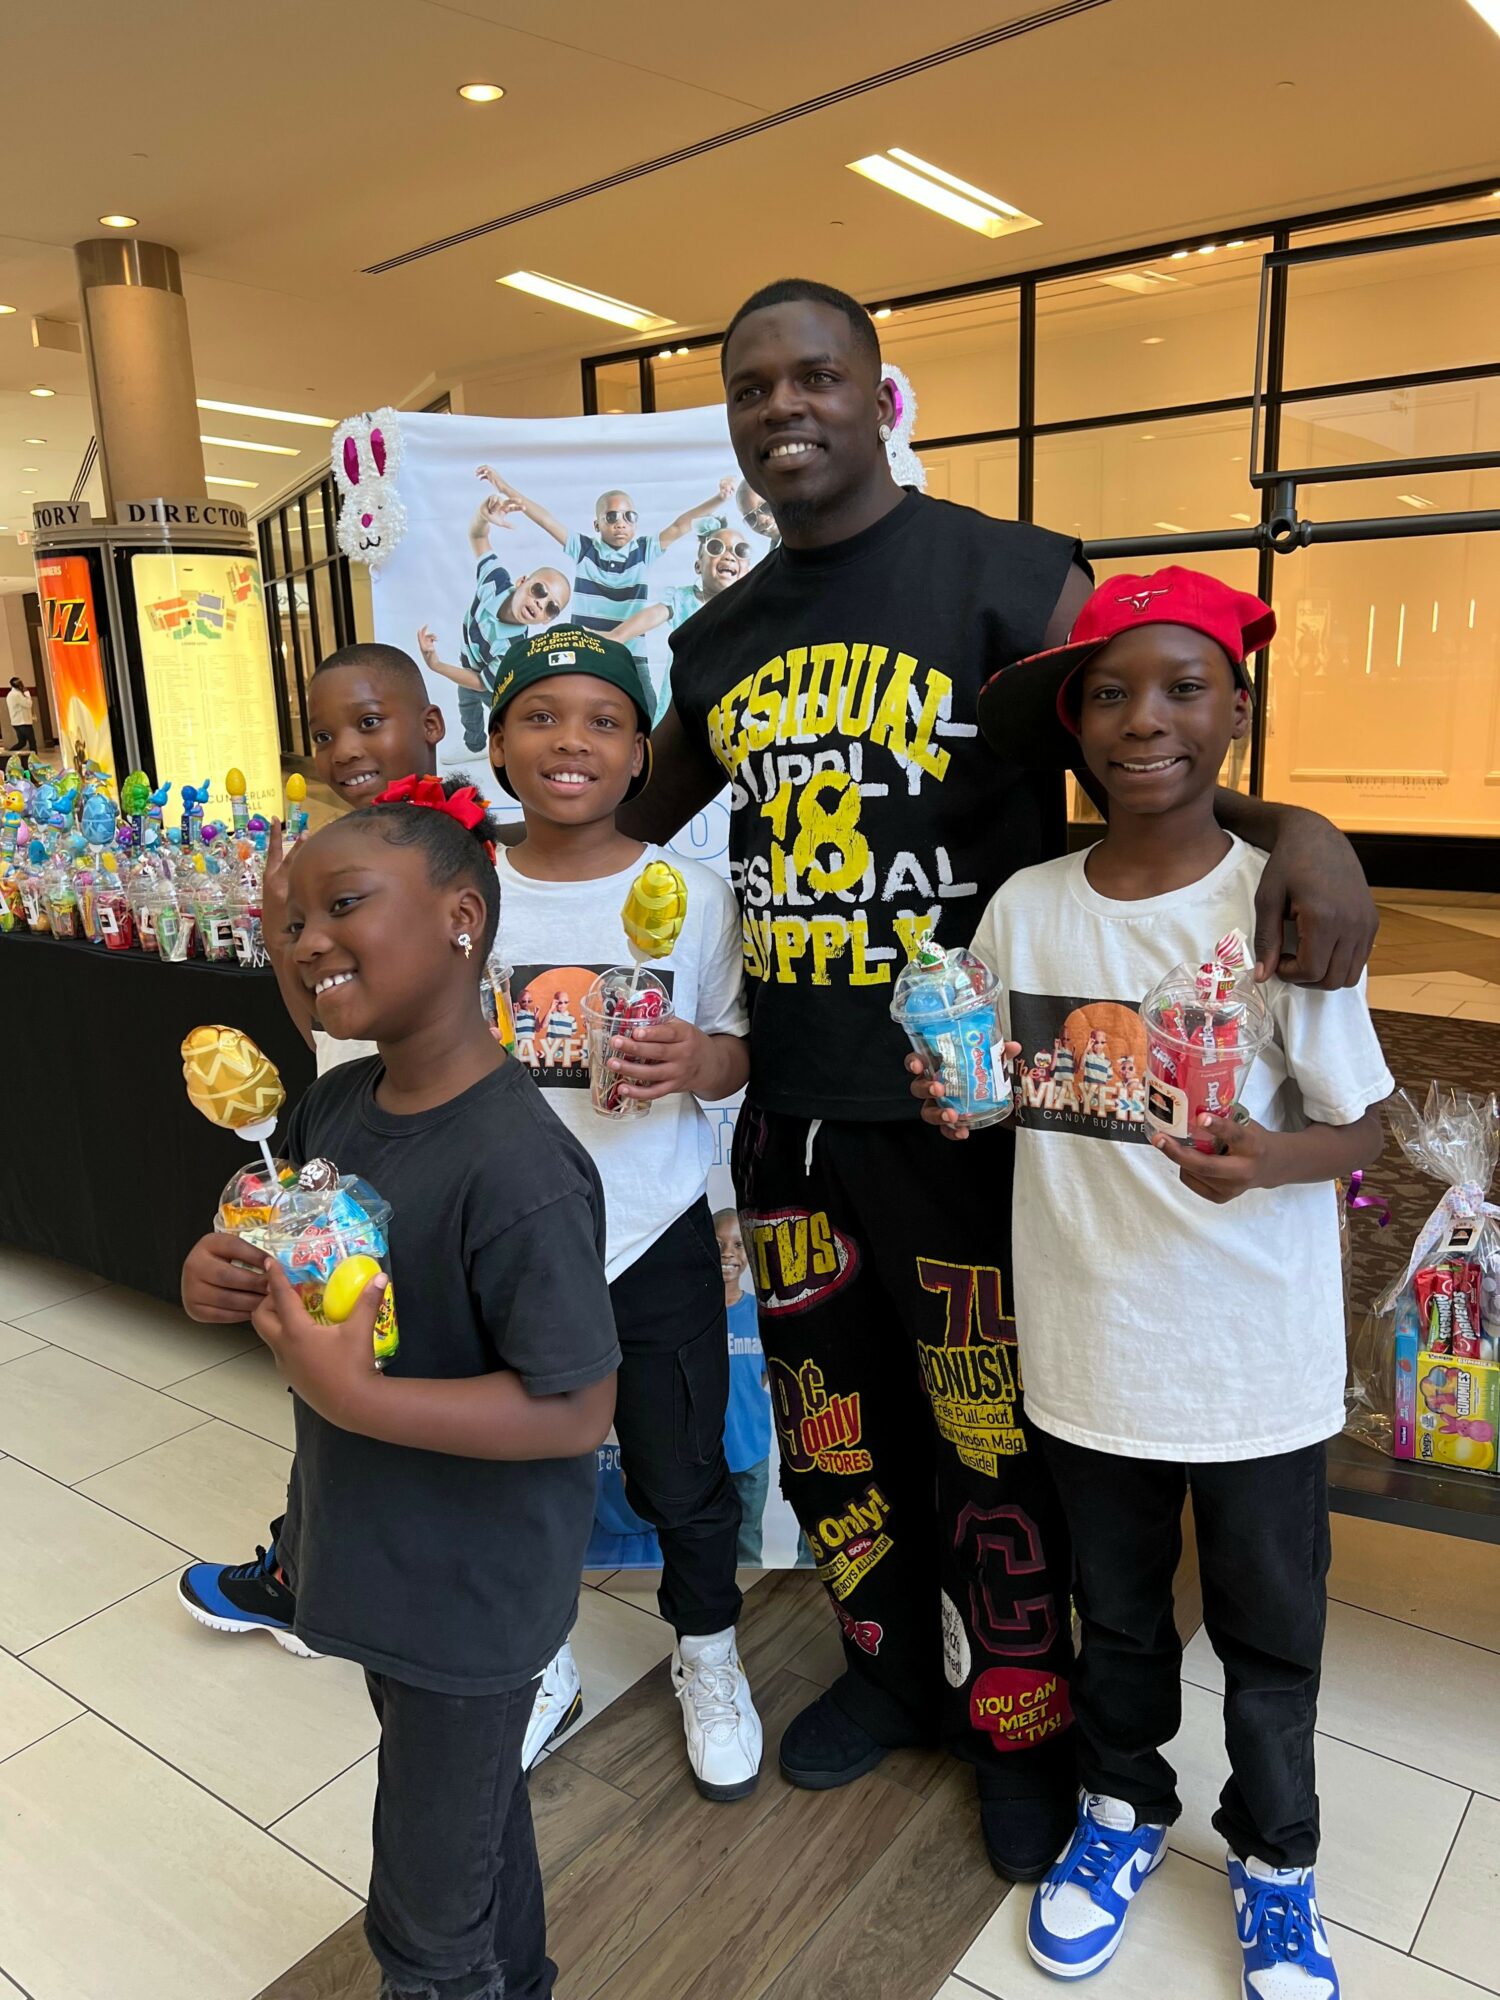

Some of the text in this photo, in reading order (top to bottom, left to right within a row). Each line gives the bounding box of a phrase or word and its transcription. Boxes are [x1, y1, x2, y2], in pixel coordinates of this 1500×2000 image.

[761, 770, 869, 893] 18
[556, 1068, 589, 1078] BUSI
[1043, 1110, 1145, 1133] CANDY BUSINE
[1434, 1293, 1452, 1340] AIRHEADS
[1453, 1291, 1477, 1340] AIRHEADS
[728, 1333, 764, 1355] Emma
[918, 1342, 1015, 1402] BONUS!
[1457, 1371, 1471, 1417] GUMMIES
[955, 1407, 1010, 1425] Pull-out
[1421, 1432, 1433, 1458] Peeps
[818, 1450, 873, 1474] STORES
[819, 1488, 891, 1548] Only!
[976, 1676, 1057, 1716] YOU CAN
[1000, 1702, 1049, 1733] MEET
[1025, 1713, 1062, 1741] TVS!
